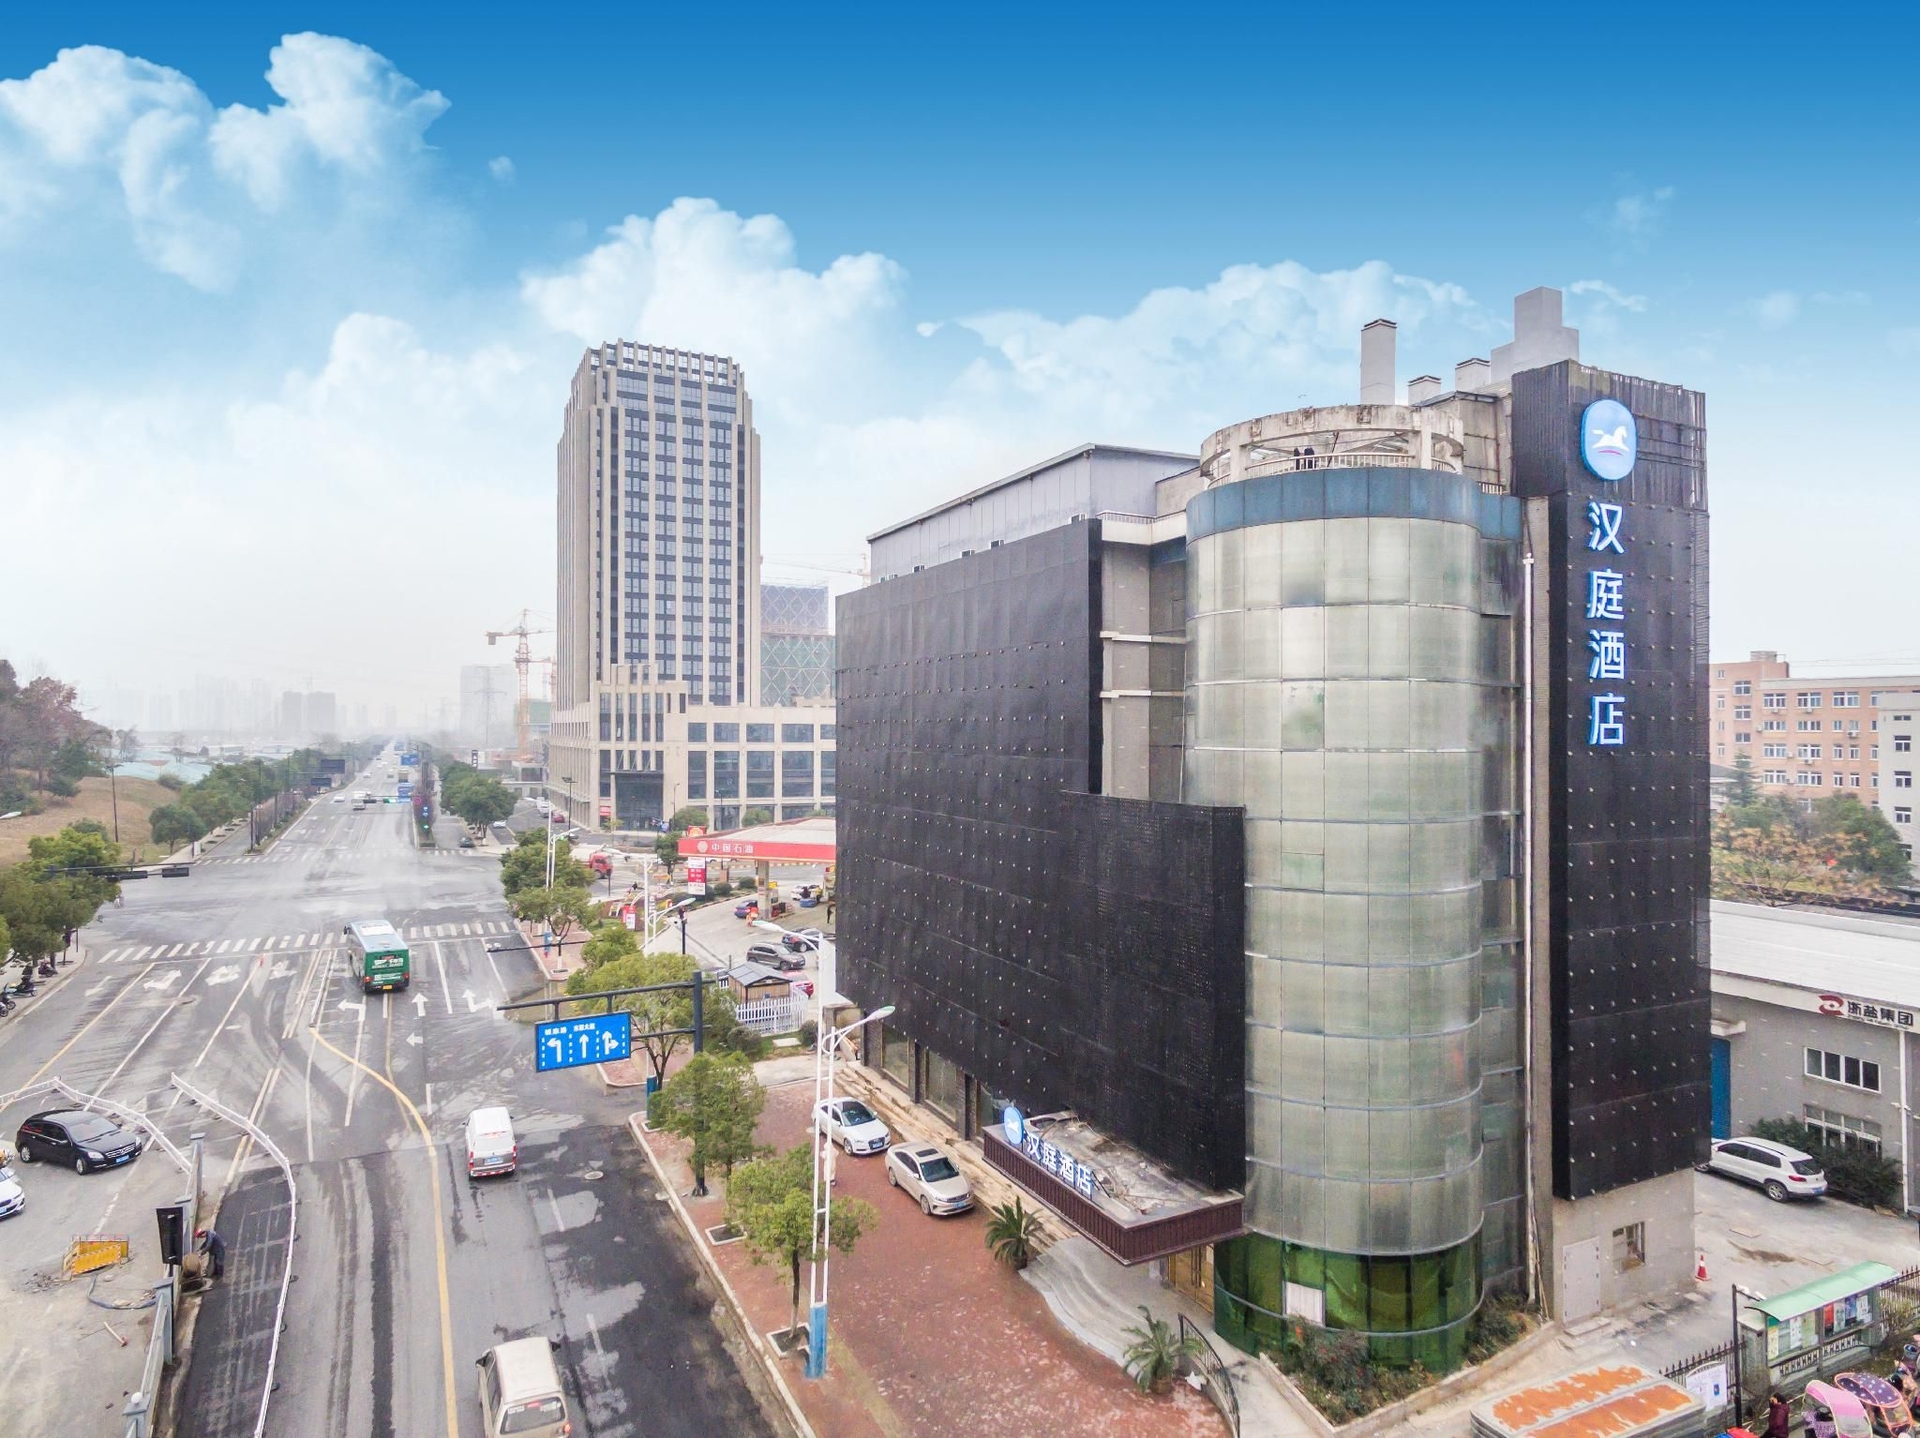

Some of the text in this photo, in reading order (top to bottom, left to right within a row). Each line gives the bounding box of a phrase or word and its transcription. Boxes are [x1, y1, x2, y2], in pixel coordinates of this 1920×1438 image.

[1588, 500, 1626, 746] 汉庭酒店
[711, 843, 755, 854] 中国石油
[1847, 1000, 1914, 1026] 浙盐集团
[1027, 1132, 1093, 1195] 汉庭酒店
